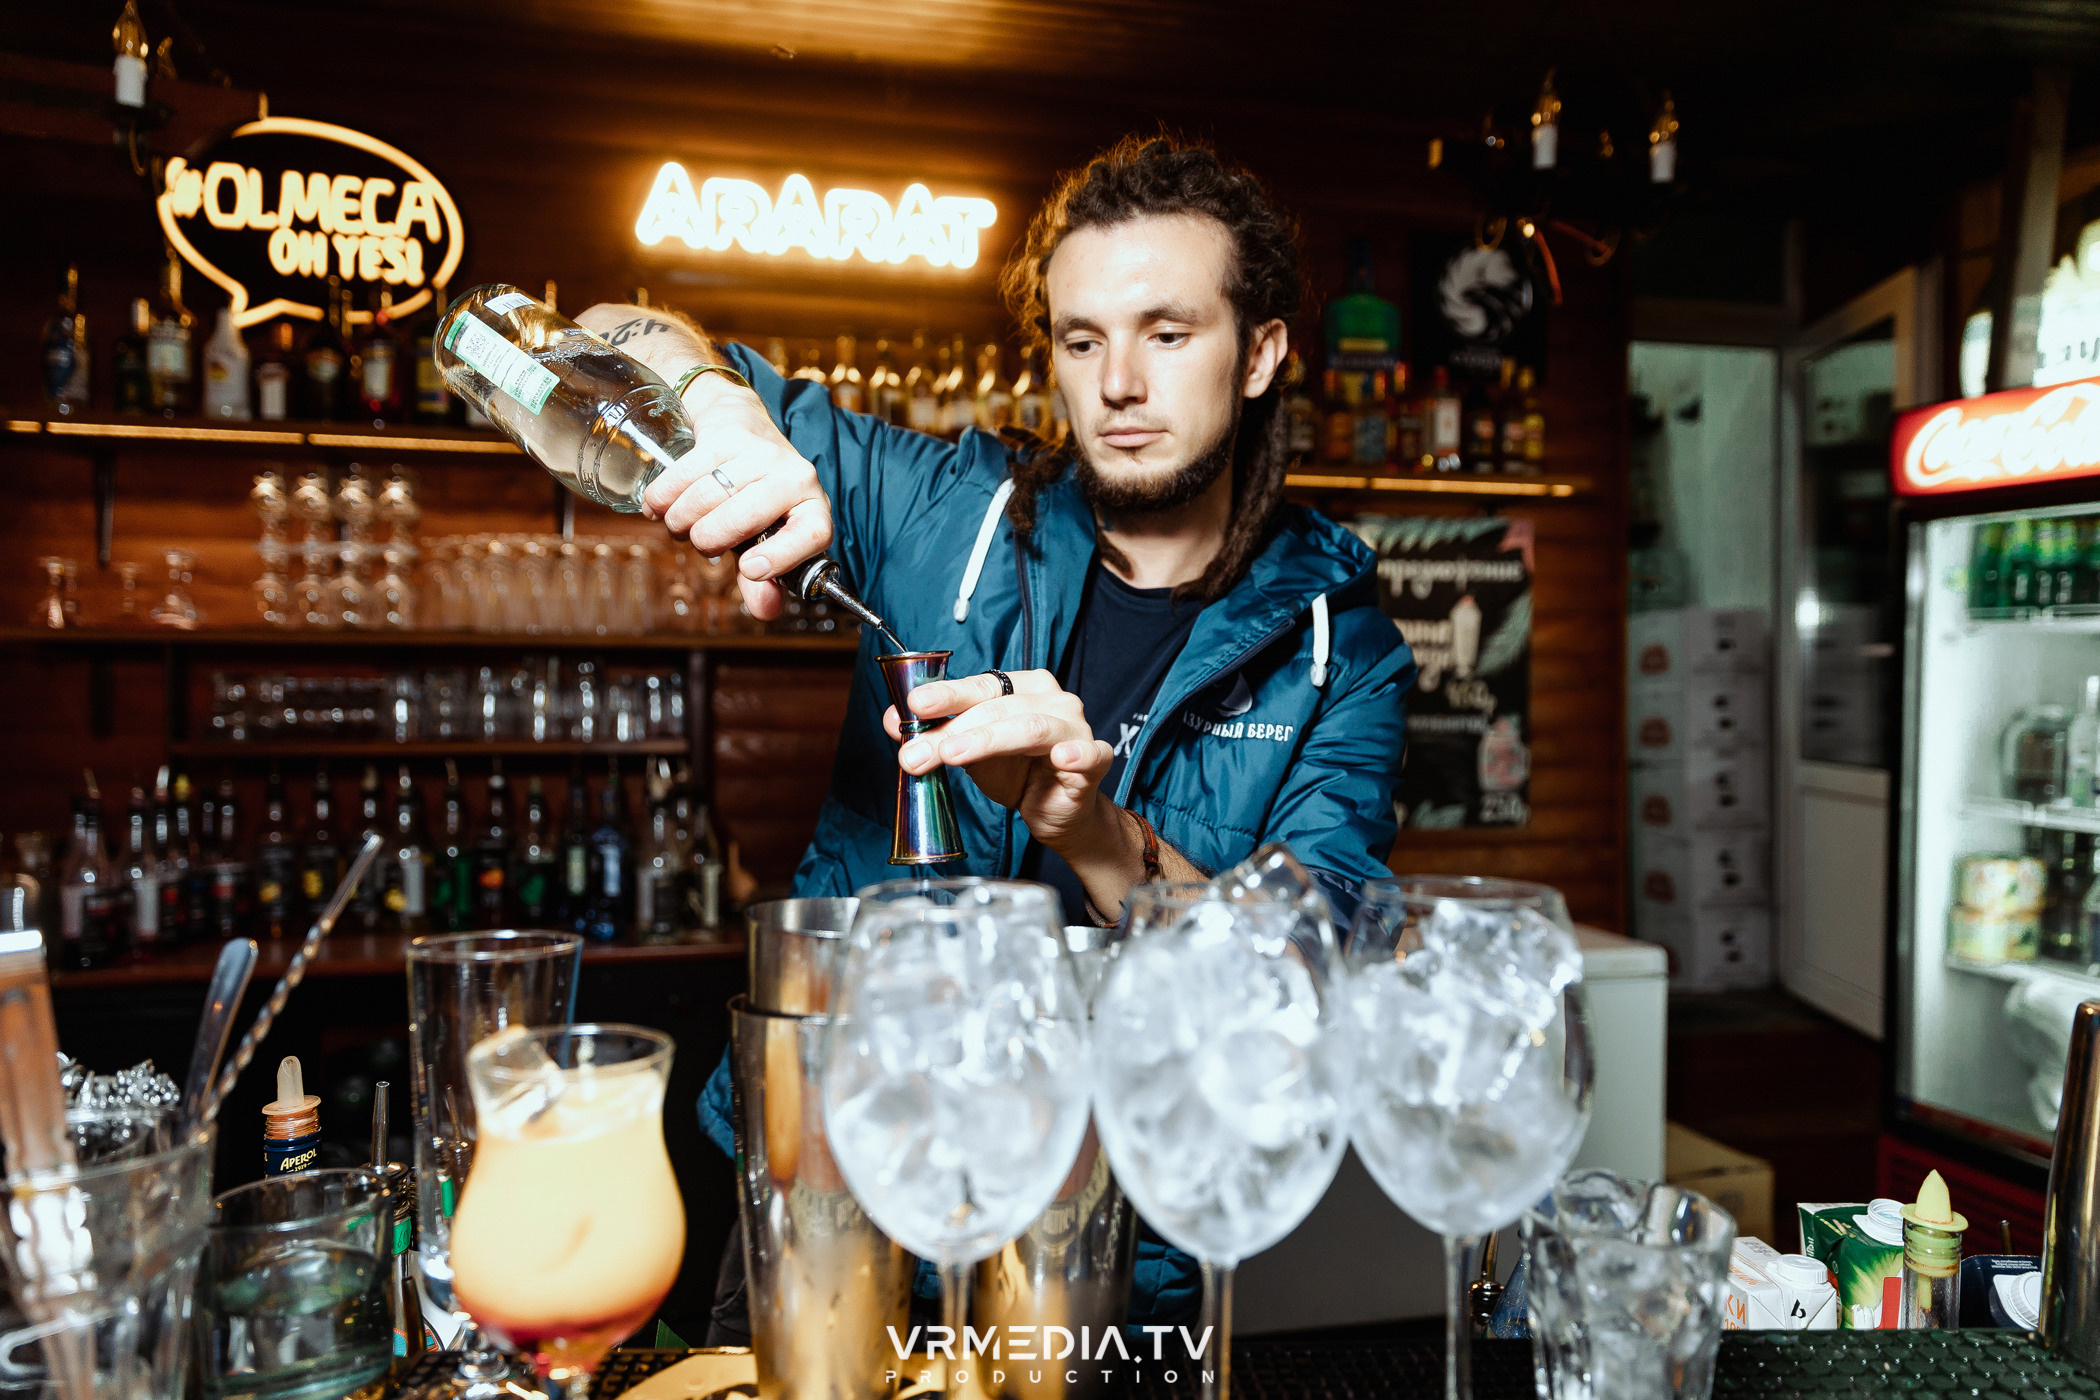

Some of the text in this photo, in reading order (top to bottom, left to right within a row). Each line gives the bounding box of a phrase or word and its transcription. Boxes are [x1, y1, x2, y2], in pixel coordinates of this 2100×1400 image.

[635, 161, 998, 269] ARARAT
[268, 227, 426, 287] OH YES!
[1246, 722, 1294, 742] БЕРЕГ
[280, 1148, 317, 1171] APEROL
